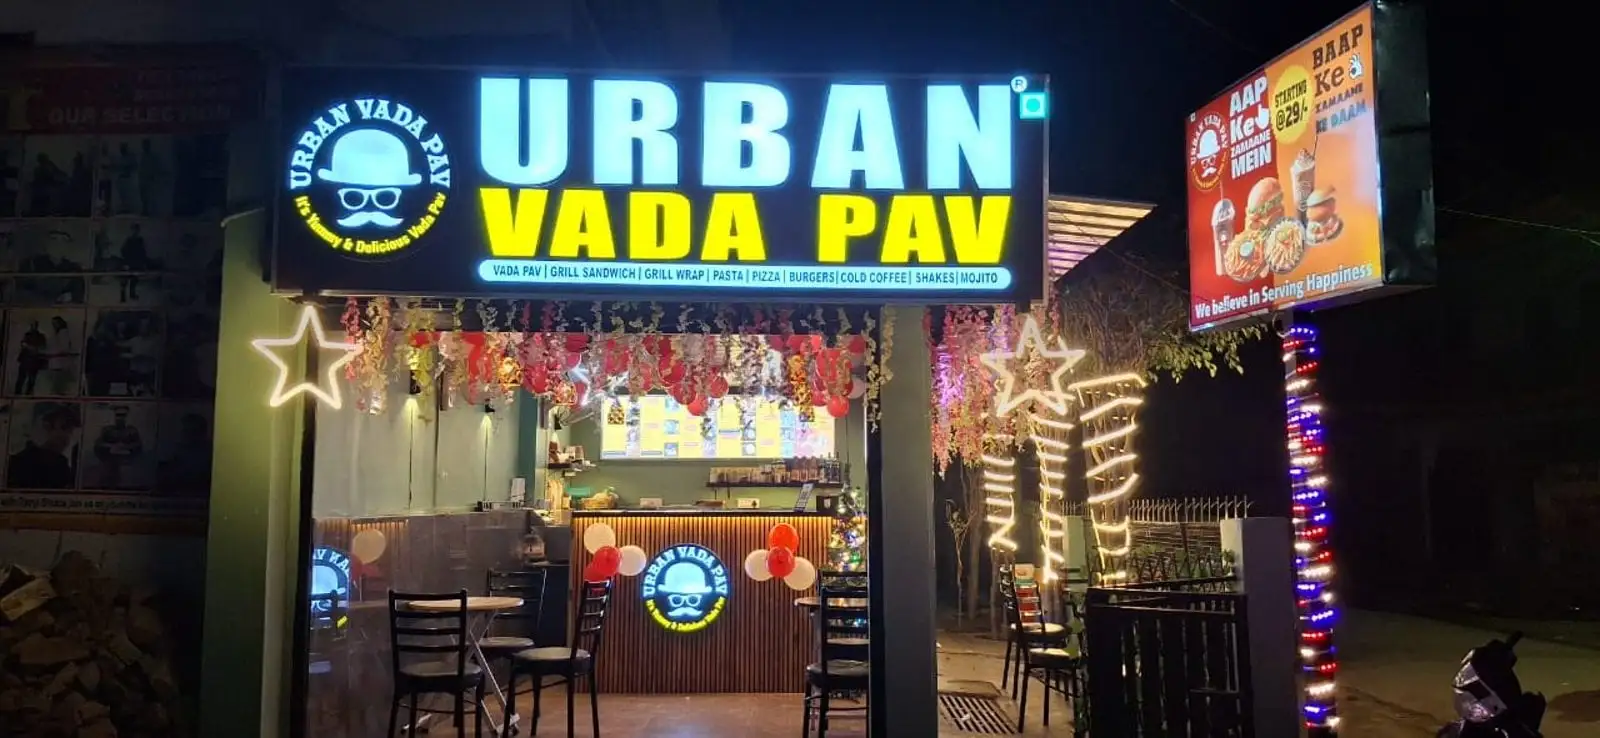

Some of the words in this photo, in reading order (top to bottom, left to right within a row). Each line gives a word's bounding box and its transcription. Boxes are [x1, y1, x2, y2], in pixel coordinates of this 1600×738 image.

[1312, 24, 1363, 70] BAAP
[1230, 76, 1267, 117] AAP
[1275, 79, 1307, 108] STARTING
[1314, 66, 1344, 97] Ke
[290, 103, 351, 189] URBAN
[354, 99, 428, 140] VADA
[419, 133, 450, 188] PAV
[480, 77, 1012, 189] URBAN
[1230, 114, 1254, 144] Ke
[1231, 142, 1272, 179] MEIN
[343, 237, 354, 251] &
[355, 234, 411, 254] Delicious
[407, 215, 436, 239] Vada
[428, 192, 447, 215] Pav
[479, 187, 767, 261] VADA
[818, 193, 1012, 264] PAV
[494, 265, 519, 277] VADA
[523, 265, 541, 278] PAV
[550, 266, 579, 278] GRILL
[583, 267, 635, 280] SANDWICH
[644, 269, 673, 281] GRILL
[676, 270, 704, 281] WRAP
[713, 270, 743, 282] PASTA
[752, 271, 780, 282] PIZZA
[789, 271, 835, 283] BURGERS
[841, 272, 867, 283] COLD
[869, 272, 907, 284] COFFEE
[916, 272, 954, 284] SHAKES
[961, 272, 998, 284] MOJITO
[1194, 303, 1211, 319] We
[1212, 295, 1248, 317] believe
[1250, 288, 1261, 305] in
[1261, 280, 1305, 303] Serving
[1306, 262, 1373, 292] Happiness
[643, 549, 676, 597] URBAN
[677, 546, 716, 568] VADA
[711, 564, 728, 594] PAV
